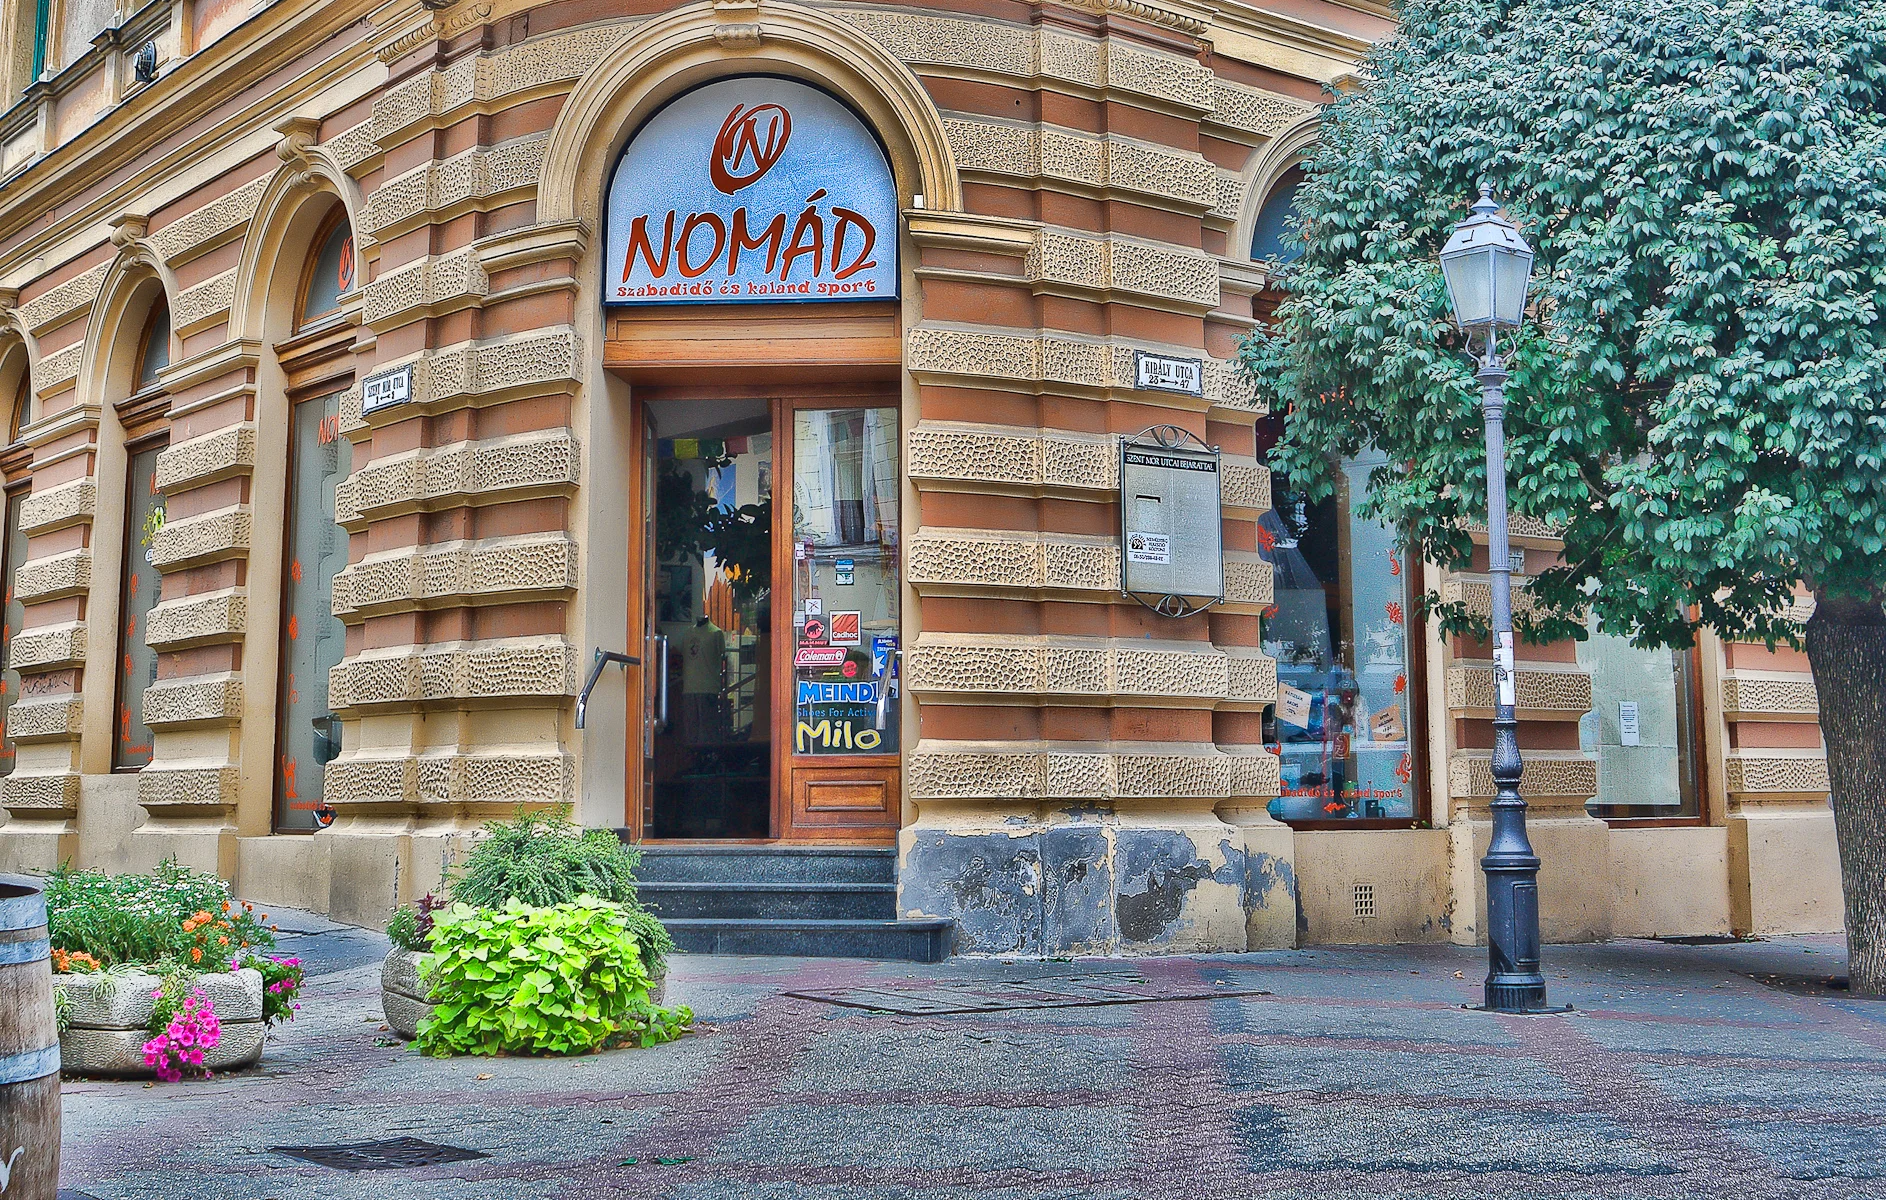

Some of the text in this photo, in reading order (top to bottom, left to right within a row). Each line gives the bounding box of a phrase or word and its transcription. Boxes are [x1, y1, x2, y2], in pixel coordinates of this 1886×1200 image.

[622, 188, 877, 283] NOMÁD
[616, 279, 876, 297] szabadidő és kaland sport
[1145, 359, 1194, 380] KIRÁLY UTCA
[1126, 454, 1145, 464] SZENT
[1160, 458, 1179, 467] UTCAI
[799, 649, 834, 661] Coleman
[829, 708, 844, 717] For
[797, 719, 882, 752] Milo
[1373, 788, 1403, 799] sport
